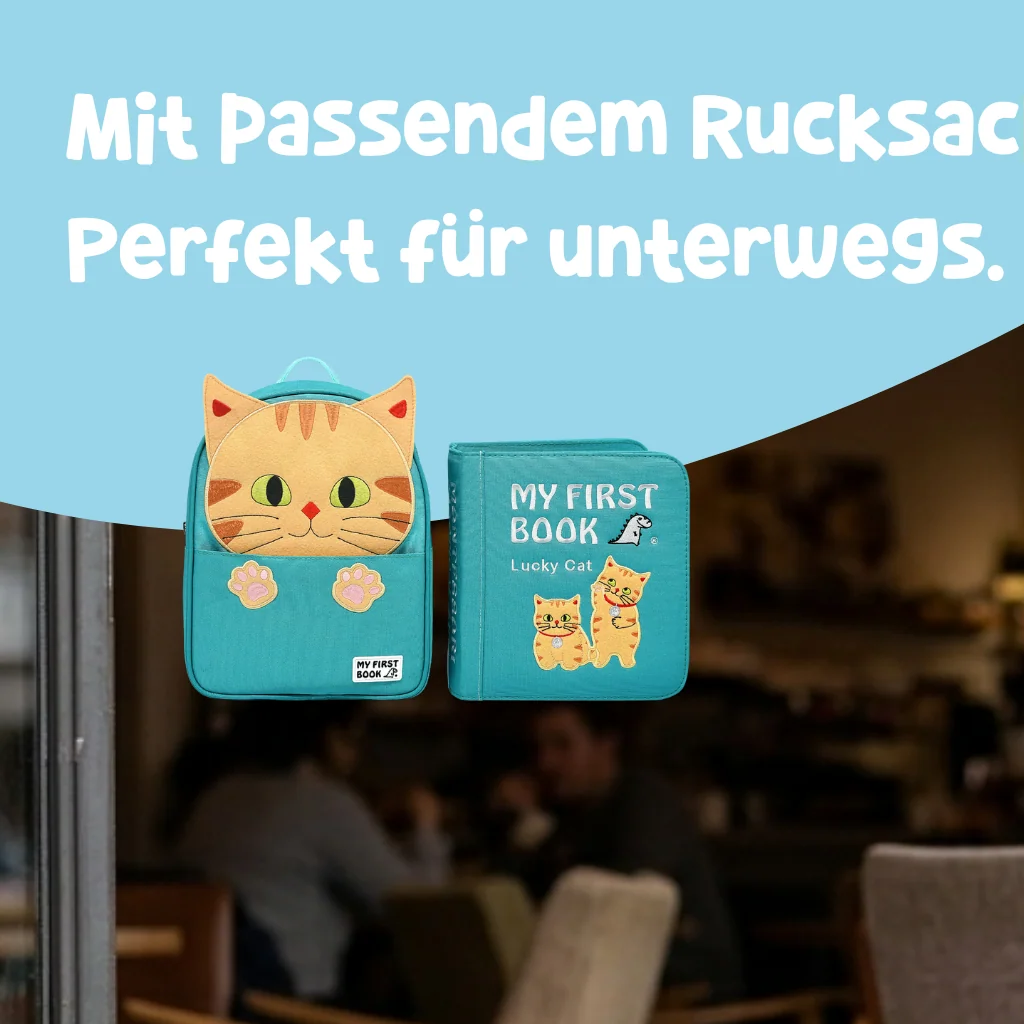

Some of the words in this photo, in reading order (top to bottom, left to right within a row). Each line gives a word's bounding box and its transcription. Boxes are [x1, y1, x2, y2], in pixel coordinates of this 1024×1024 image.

[511, 483, 558, 511] MY
[566, 483, 659, 510] FIRST
[510, 516, 599, 545] BOOK
[511, 558, 559, 575] Lucky
[564, 559, 593, 572] Cat
[356, 660, 371, 669] MY
[372, 659, 400, 669] FIRST
[356, 670, 382, 679] BOOK
